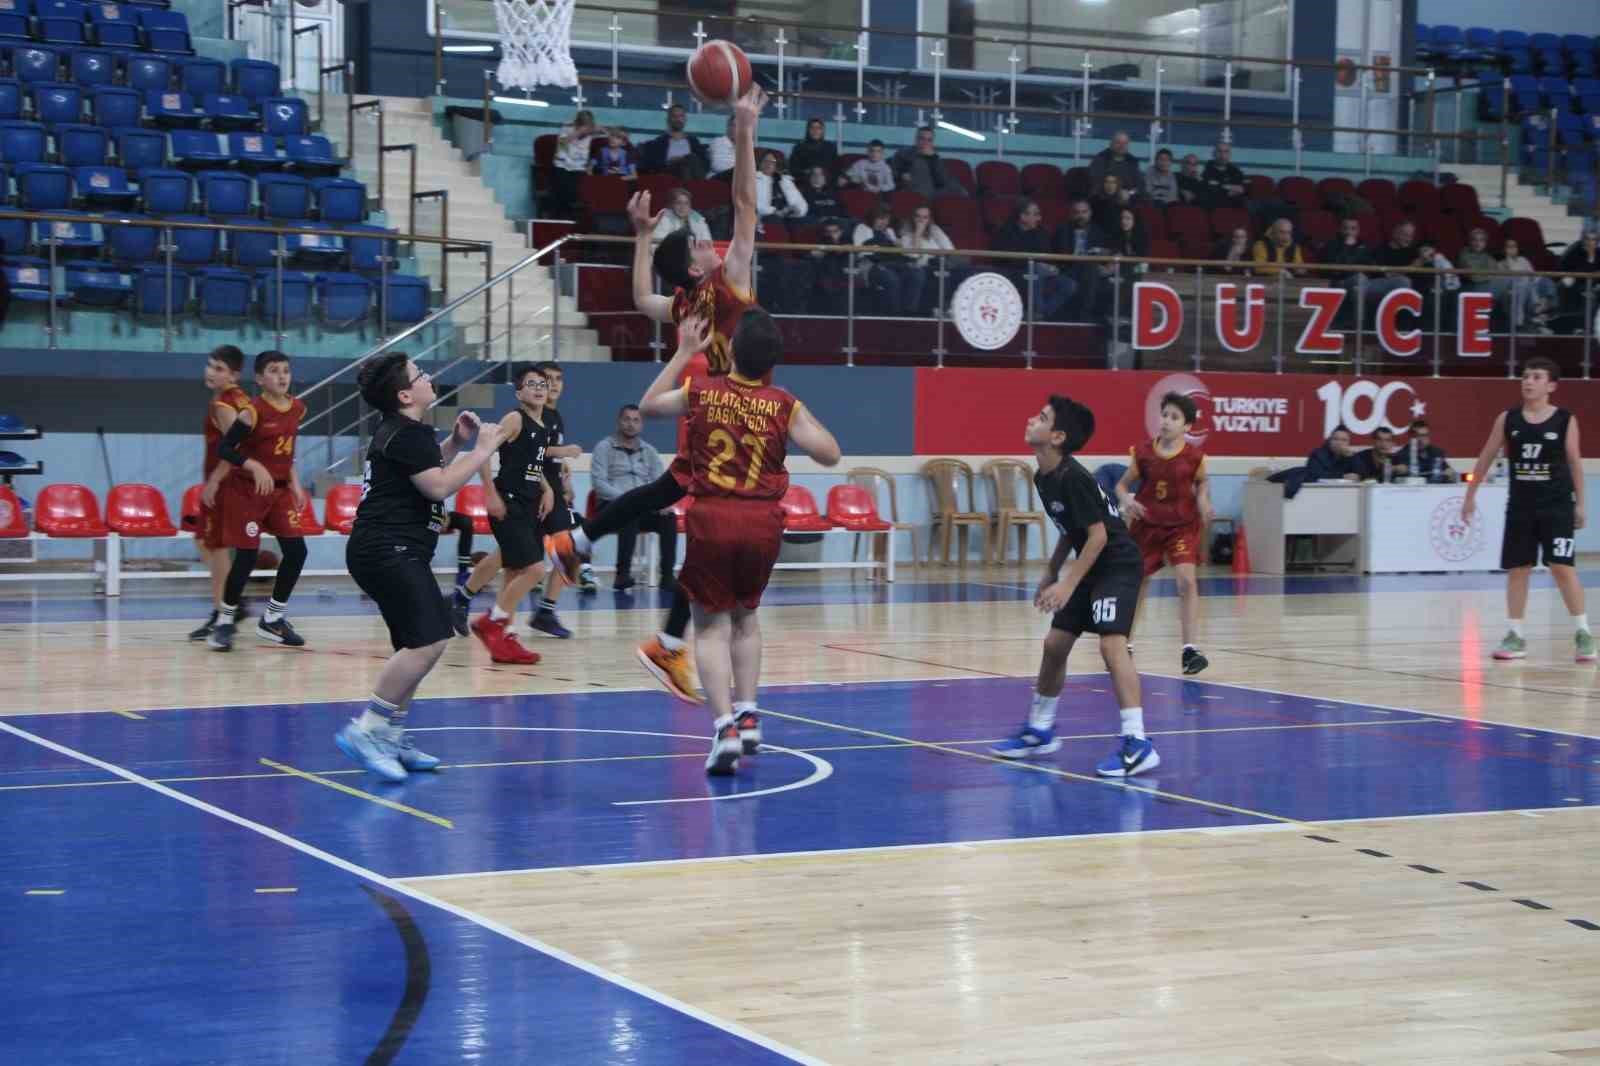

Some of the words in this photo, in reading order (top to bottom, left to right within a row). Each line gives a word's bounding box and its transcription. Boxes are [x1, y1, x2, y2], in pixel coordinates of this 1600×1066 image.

[1132, 282, 1493, 356] DÜZCE
[700, 390, 781, 417] GALATASARAY
[273, 436, 293, 455] 24
[1522, 444, 1542, 459] 37
[707, 429, 767, 489] 27
[1155, 481, 1168, 499] 5
[1553, 537, 1575, 558] 37
[1092, 598, 1116, 624] 35
